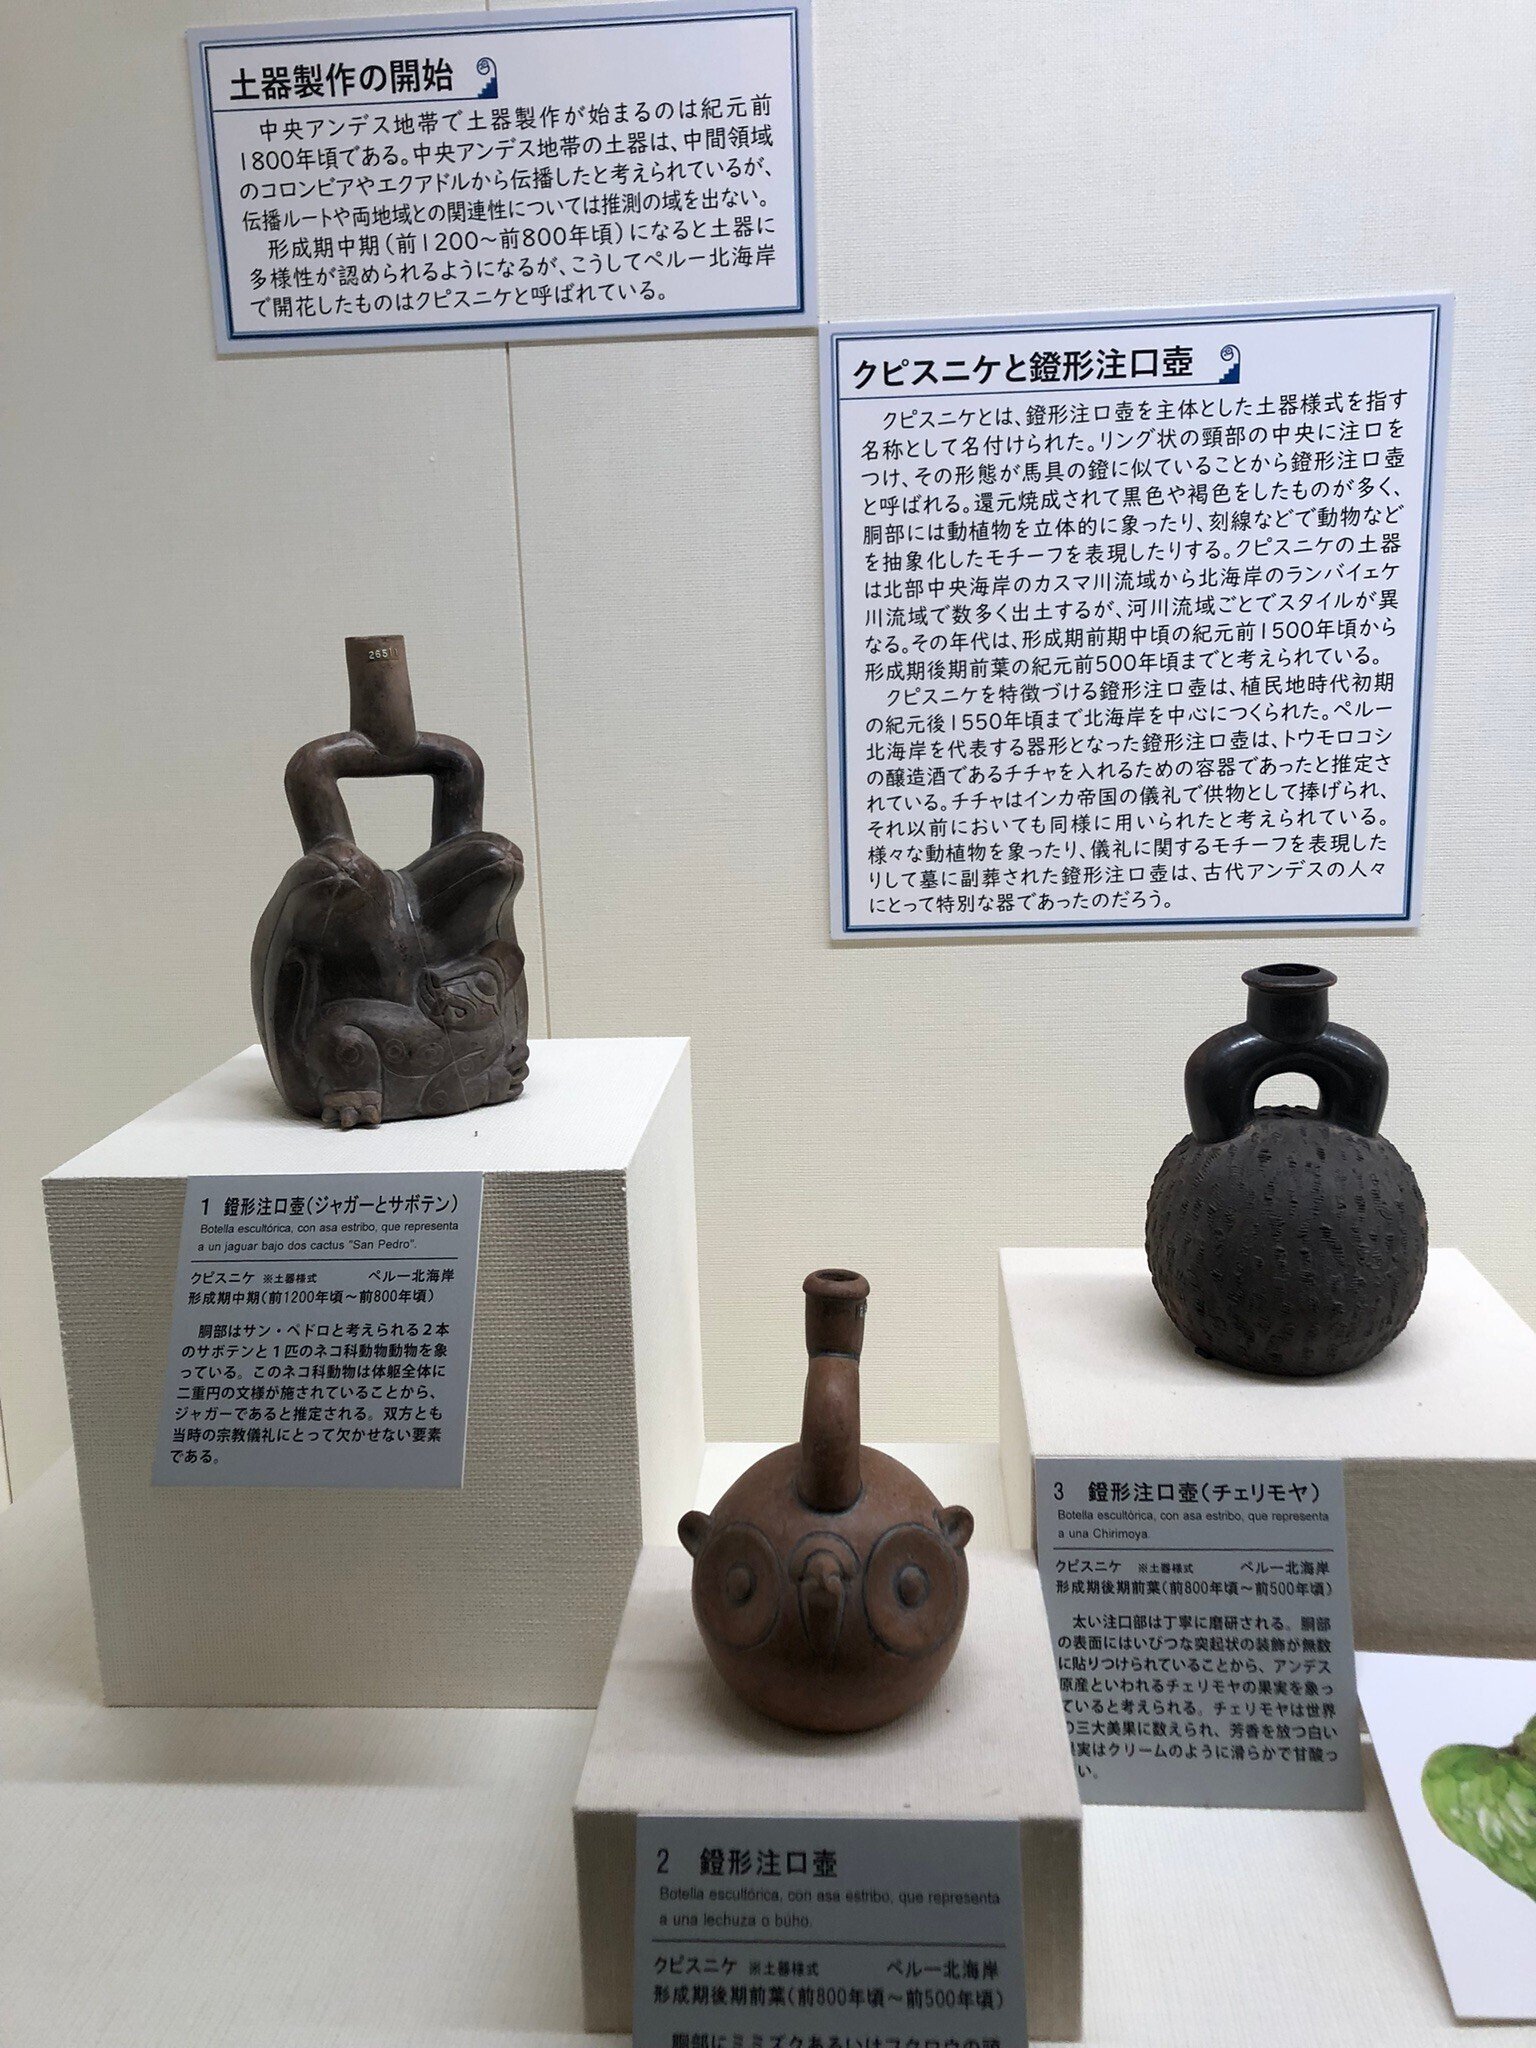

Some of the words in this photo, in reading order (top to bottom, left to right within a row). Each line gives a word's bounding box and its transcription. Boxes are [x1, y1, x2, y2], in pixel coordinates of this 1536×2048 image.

[230, 57, 453, 100] 土器製作の開始
[260, 93, 772, 142] 中央アンデス地帯で土器製作が始まるのは紀元前
[241, 124, 774, 171] 1800年頃である。中央アンデス地帯の土器は、中間領域
[240, 157, 771, 200] のコロンビアやエクアドルから伝播したと考えられているが、
[242, 188, 766, 232] 伝播ルートや両地域との関連性については推測の域を出ない。
[250, 244, 775, 290] 多様性が認められるようになるが、こうしてペルー北海岸
[250, 281, 665, 318] で開花したものはクピスニケと呼ばれている。
[853, 347, 1194, 389] クピスニケと鐙形注口壺
[883, 389, 1408, 430] クピスニケとは、鐙形注口壺を主体とした土器様式を指す
[861, 446, 1405, 488] つけ、その形態が馬具の鐙に似ていることから鐙形注口壺
[864, 477, 1399, 517] と呼ばれる。還元焼成されて黒色や褐色をしたものが多く、
[863, 504, 1404, 545] 胴部には動植物を立体的に象ったり、刻線などで動物など
[865, 533, 1402, 572] を抽象化したモチーフを表現したりする。クピスニケの土器
[865, 589, 1398, 627] 川流域で数多く出土するが、河川流域ごとでスタイルが異
[865, 617, 1395, 654] なる。その年代は、形成期前期中頃の紀元前1500年頃から
[865, 646, 1379, 682] 形成期後期前葉の紀元前500年頃までと考えられている。
[887, 672, 1394, 707] クピスニケを特徴づける鐙形注口壺は、植民地時代初期
[866, 701, 1392, 735] の紀元後1550年頃まで北海岸を中心につくられた。ペルー
[866, 728, 1392, 761] 北海岸を代表する器形となった鐙形注口壺は、トウモロコシ
[867, 753, 1391, 787] の醸造酒であるチチャを入れるための容器であったと推定さ
[868, 808, 1386, 839] それ以前においても同様に用いられたと考えられている。
[868, 833, 1386, 865] 様々な動植物を象ったり、儀礼に関するモチーフを表現した
[870, 860, 1385, 889] りして墓に副葬された鐙形注口壺は、古代アンデスの人々
[870, 890, 1171, 913] にとって特別な器であったのだろう。
[201, 1198, 209, 1215] 1
[200, 1223, 235, 1234] Botella
[237, 1222, 294, 1234] escultórica,
[297, 1224, 316, 1233] con
[319, 1223, 338, 1233] asa
[341, 1221, 378, 1233] estribo,
[381, 1222, 401, 1234] que
[404, 1221, 459, 1234] representa
[197, 1243, 204, 1252] a
[170, 1449, 218, 1464] である。
[1054, 1481, 1064, 1501] 3
[1058, 1530, 1065, 1539] a
[657, 1848, 669, 1874] 2
[699, 1848, 837, 1878] 鐙形注口壺
[659, 1915, 667, 1927] a
[761, 1916, 770, 1927] o
